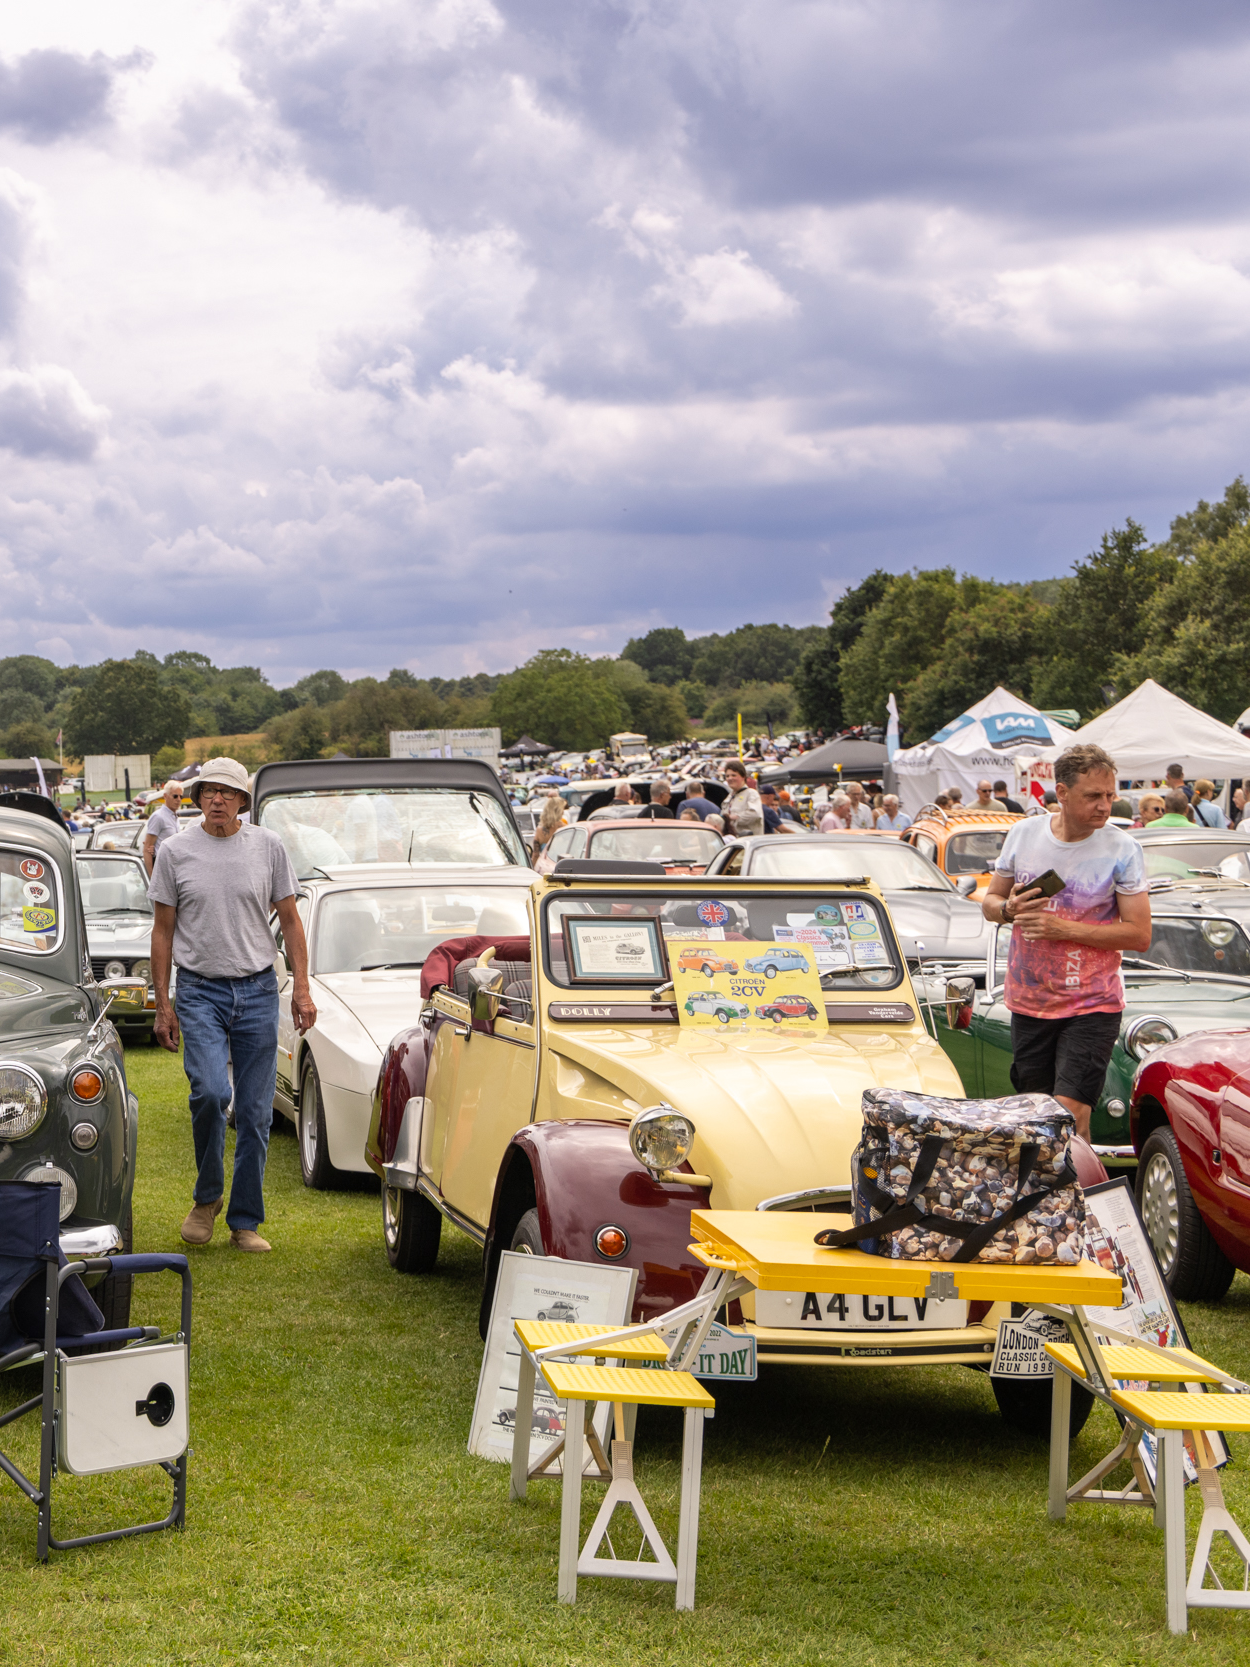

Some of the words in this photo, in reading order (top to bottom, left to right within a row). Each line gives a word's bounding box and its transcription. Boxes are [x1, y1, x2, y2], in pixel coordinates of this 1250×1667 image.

[1065, 949, 1081, 990] IBIZA
[729, 977, 765, 985] CITROËN
[731, 985, 767, 997] 2CV
[560, 1007, 611, 1016] DOLLY
[800, 1291, 849, 1322] A4
[710, 1329, 721, 1337] 2022
[1002, 1324, 1039, 1350] LONDON
[719, 1348, 749, 1375] DAY
[1000, 1351, 1037, 1362] CLASSIC
[998, 1362, 1020, 1372] RUN
[1028, 1363, 1053, 1373] 1998
